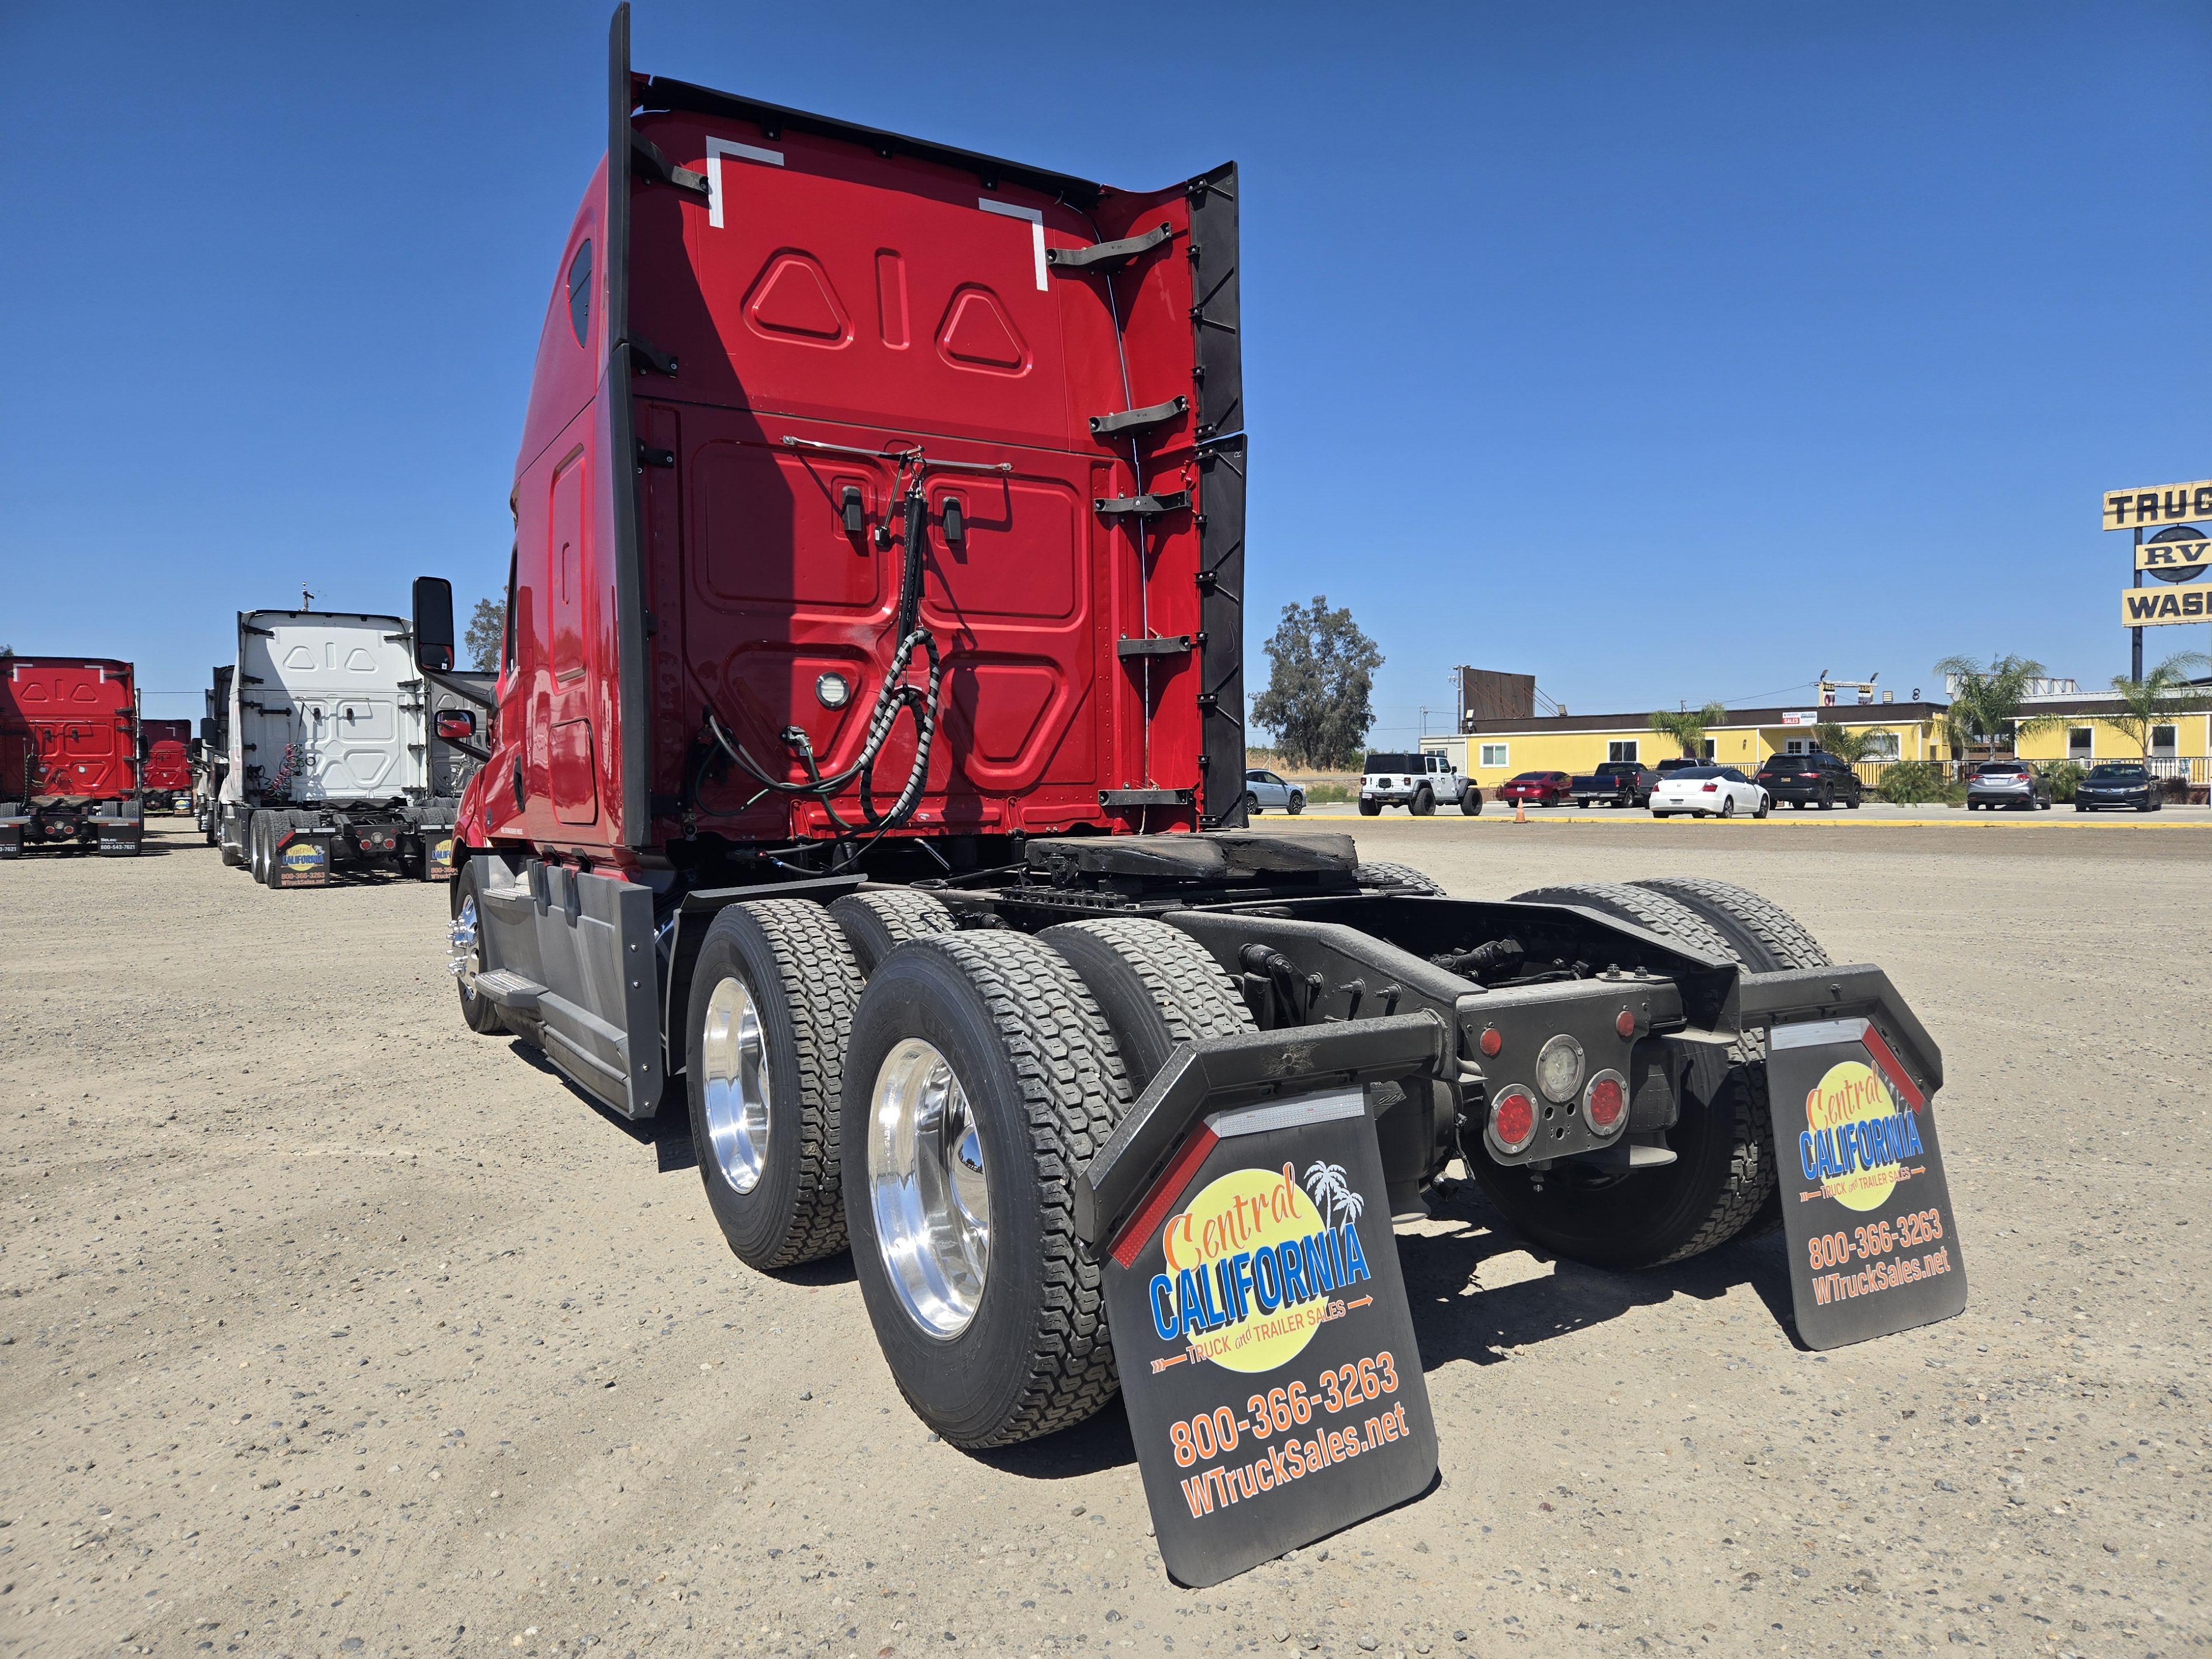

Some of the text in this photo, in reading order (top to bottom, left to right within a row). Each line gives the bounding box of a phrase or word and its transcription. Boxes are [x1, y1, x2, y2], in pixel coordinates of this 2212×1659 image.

[2109, 487, 2212, 524] TRUC
[2144, 542, 2211, 566] RV
[2127, 591, 2212, 619] WAS
[281, 872, 325, 880] 800-366-3263
[282, 854, 324, 865] CALIFORNIA
[432, 850, 451, 859] CALIF
[1806, 1059, 1883, 1133] Central
[1799, 1110, 1924, 1180] CALIFORNIA
[1820, 1166, 1911, 1199] TRUCK and TRAILER SALES
[1163, 1161, 1302, 1272] Central
[1808, 1208, 1943, 1270] 800-366-3263
[1149, 1222, 1371, 1341] CALIFORNIA
[1812, 1246, 1950, 1305] WTruckSales.net
[1186, 1300, 1346, 1364] TRUCK and TRAILER SALES
[1170, 1351, 1399, 1468] 800-366-3263
[1180, 1401, 1410, 1519] WTruckSales.net
